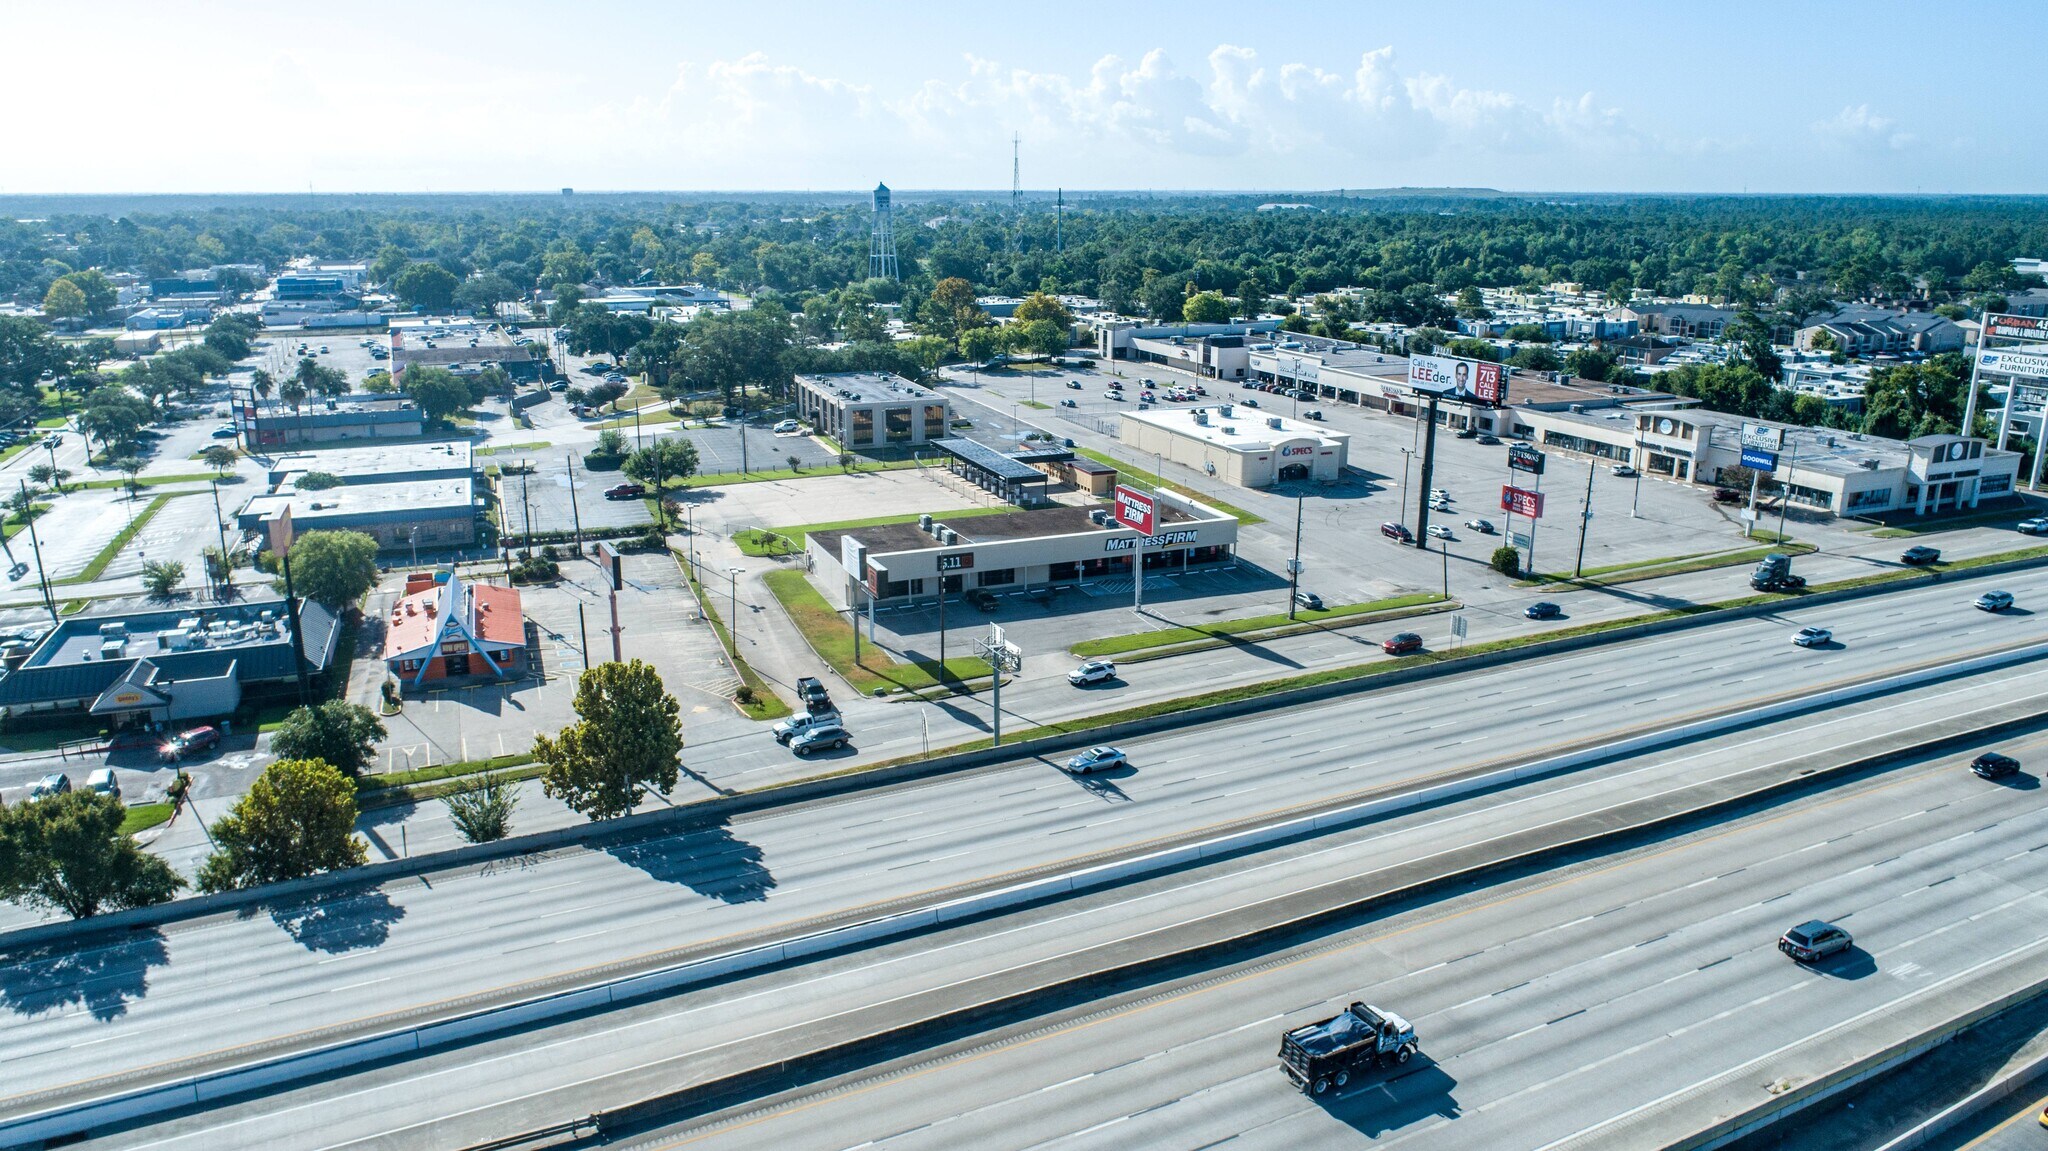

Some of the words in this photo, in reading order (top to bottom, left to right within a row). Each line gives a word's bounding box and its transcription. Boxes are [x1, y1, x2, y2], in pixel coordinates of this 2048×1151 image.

[1998, 317, 2037, 328] URBAN
[2036, 320, 2048, 330] AI
[1412, 358, 1425, 367] Call
[1427, 361, 1438, 369] the
[1411, 366, 1452, 385] LEEder.
[1480, 370, 1496, 383] 713
[1479, 381, 1495, 390] CALL
[1478, 388, 1494, 400] LEE
[1742, 439, 1778, 450] FURNITURE
[1743, 433, 1778, 445] EXCLUSIVE
[1742, 454, 1773, 466] GOODWILL
[1117, 491, 1152, 515] MATTRESS
[1124, 506, 1144, 524] FIRM
[942, 556, 961, 570] 5.11
